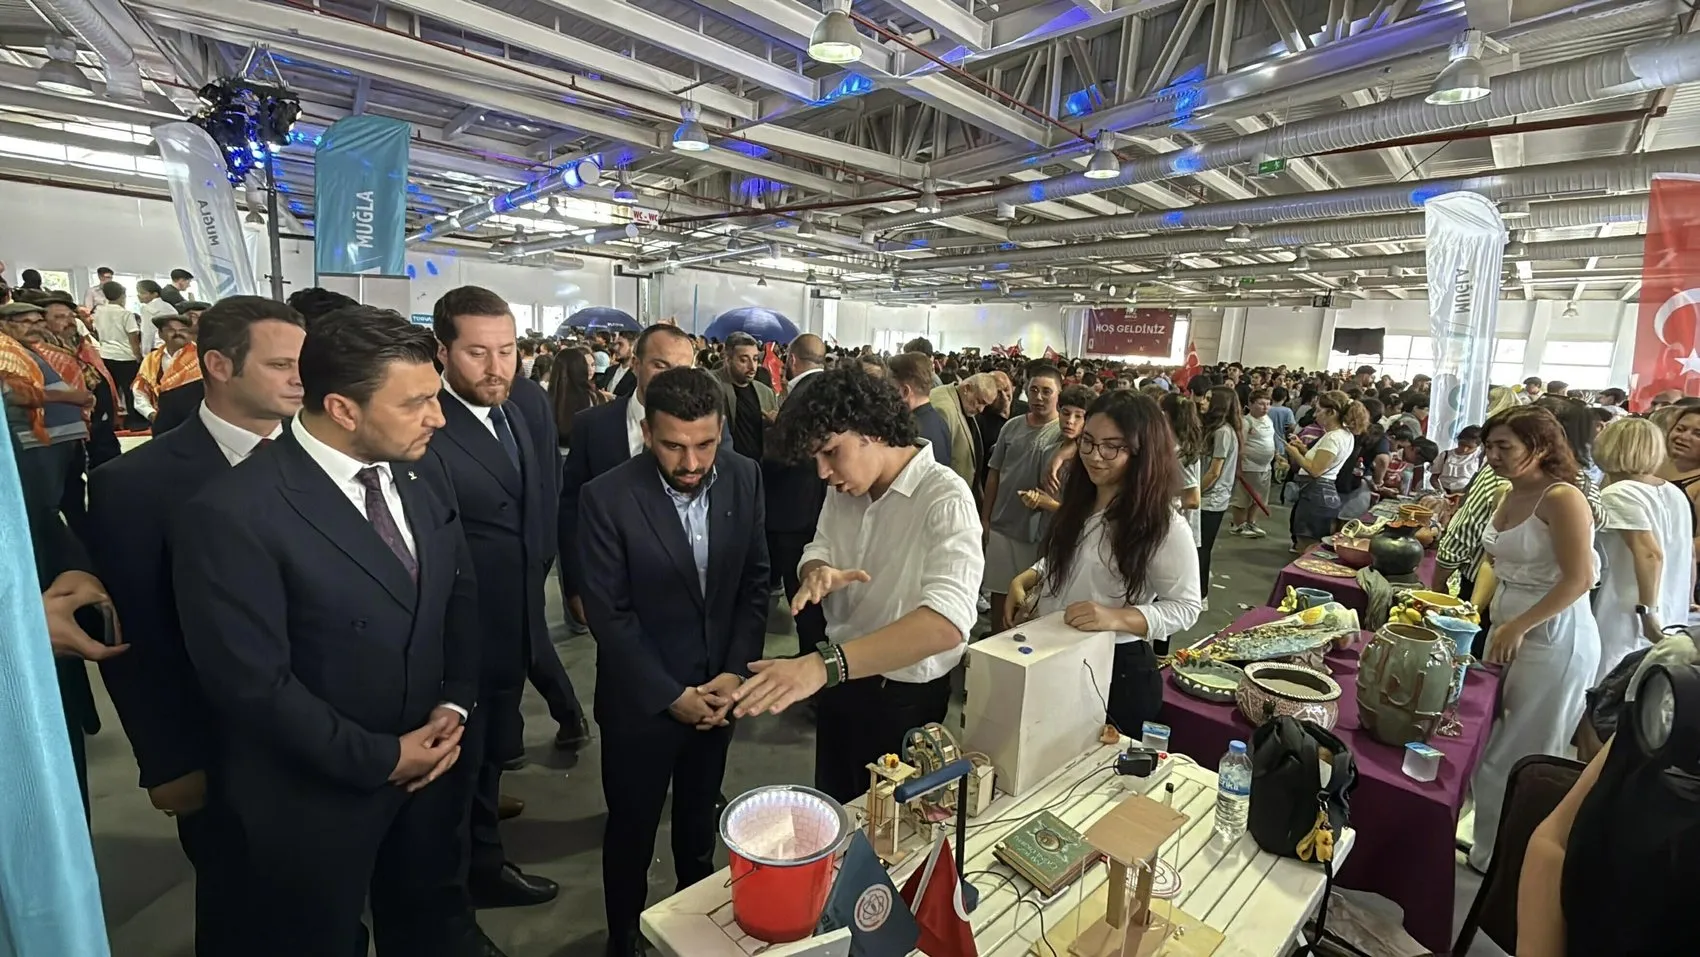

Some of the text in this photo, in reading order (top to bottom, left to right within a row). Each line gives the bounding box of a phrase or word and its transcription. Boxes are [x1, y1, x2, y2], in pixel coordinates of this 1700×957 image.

[352, 190, 374, 248] MUĞLA
[633, 211, 643, 219] WC
[649, 212, 658, 222] WC
[1095, 323, 1166, 335] HOŞ GELDİNİZ
